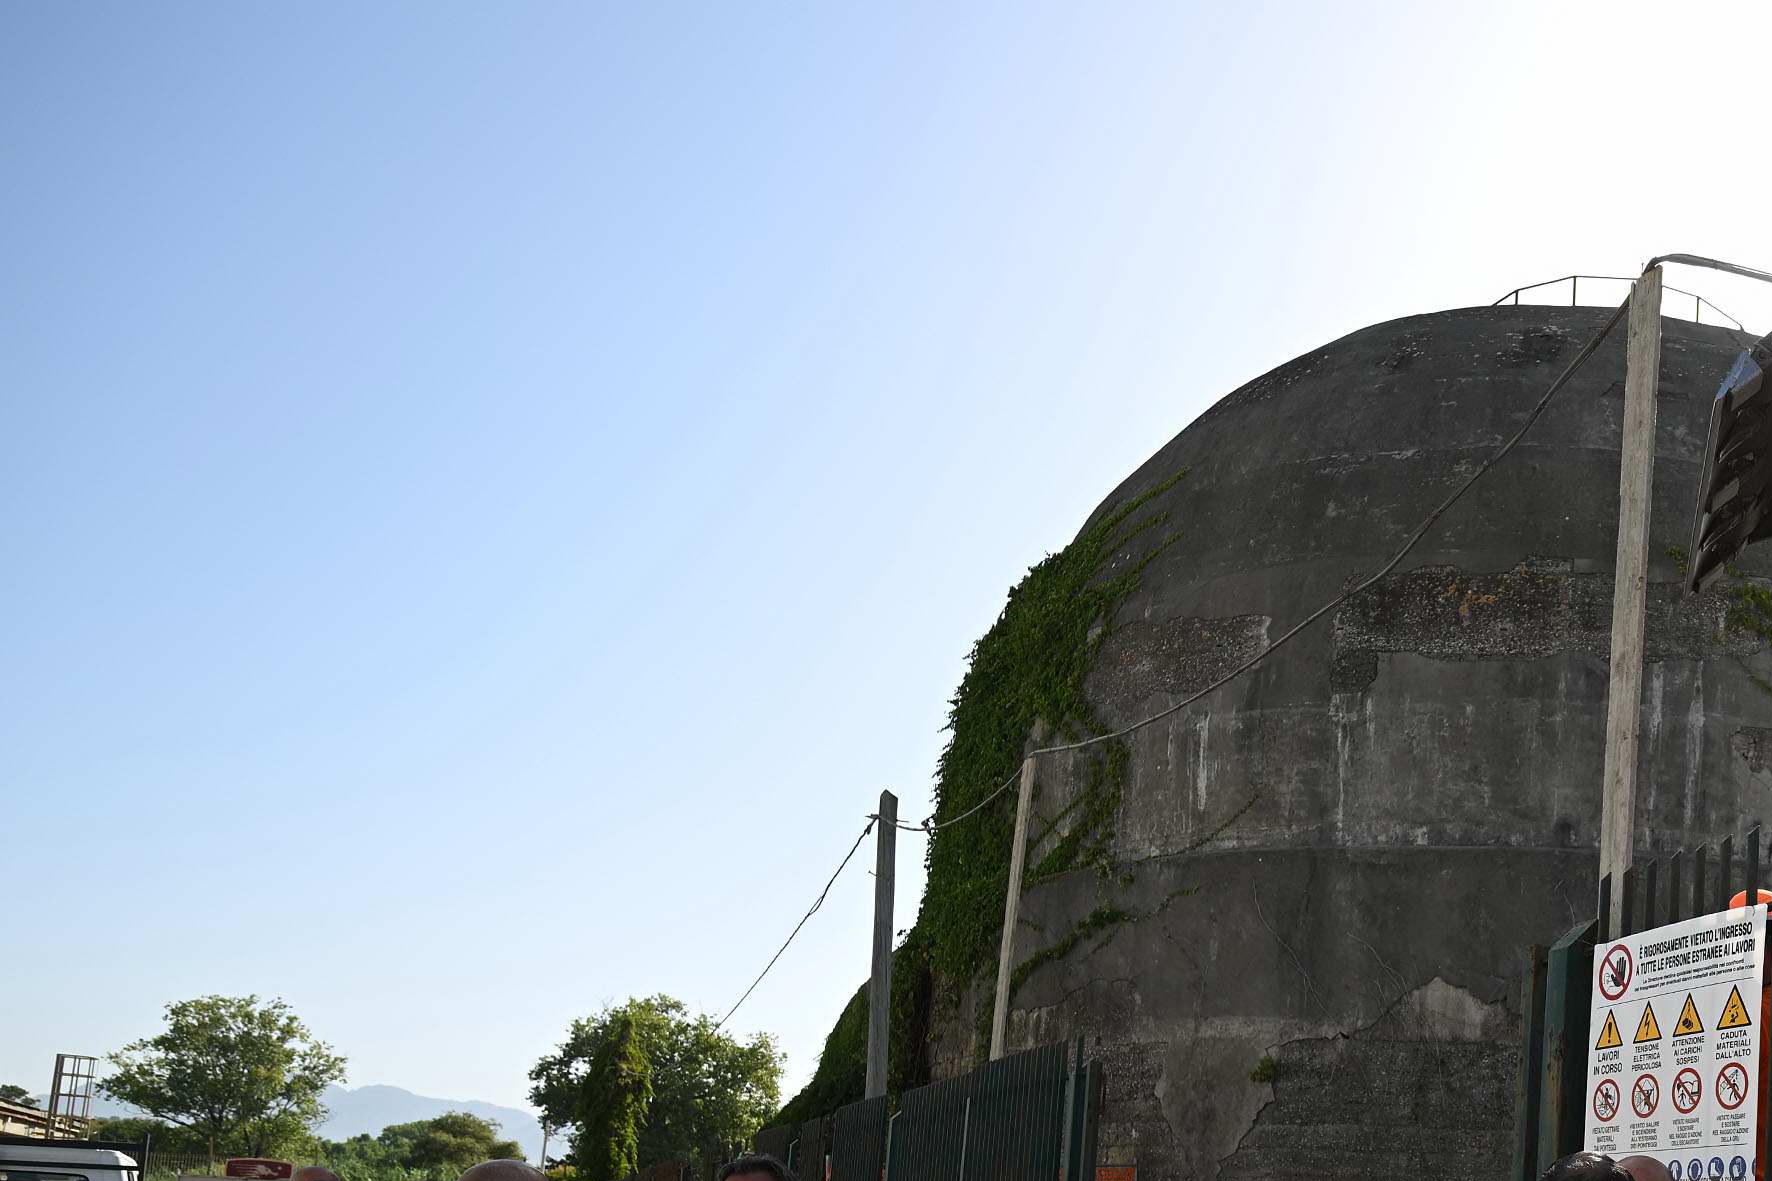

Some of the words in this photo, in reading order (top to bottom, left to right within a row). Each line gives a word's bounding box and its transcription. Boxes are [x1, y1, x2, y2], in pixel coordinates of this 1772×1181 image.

[1690, 931, 1713, 947] VIETATO
[1714, 922, 1753, 942] L'INGRESSO
[1641, 960, 1657, 976] TUTTE
[1657, 959, 1665, 972] LE
[1665, 952, 1691, 970] PERSONE
[1692, 947, 1723, 964] ESTRANEE
[1731, 939, 1756, 955] LAVORI
[1720, 1030, 1747, 1040] CADUTA
[1716, 1039, 1751, 1050] MATERIALI
[1597, 1051, 1620, 1062] LAVORI
[1715, 1048, 1751, 1060] DALL'ALTO
[1593, 1066, 1600, 1076] IN
[1600, 1063, 1623, 1074] CORSO
